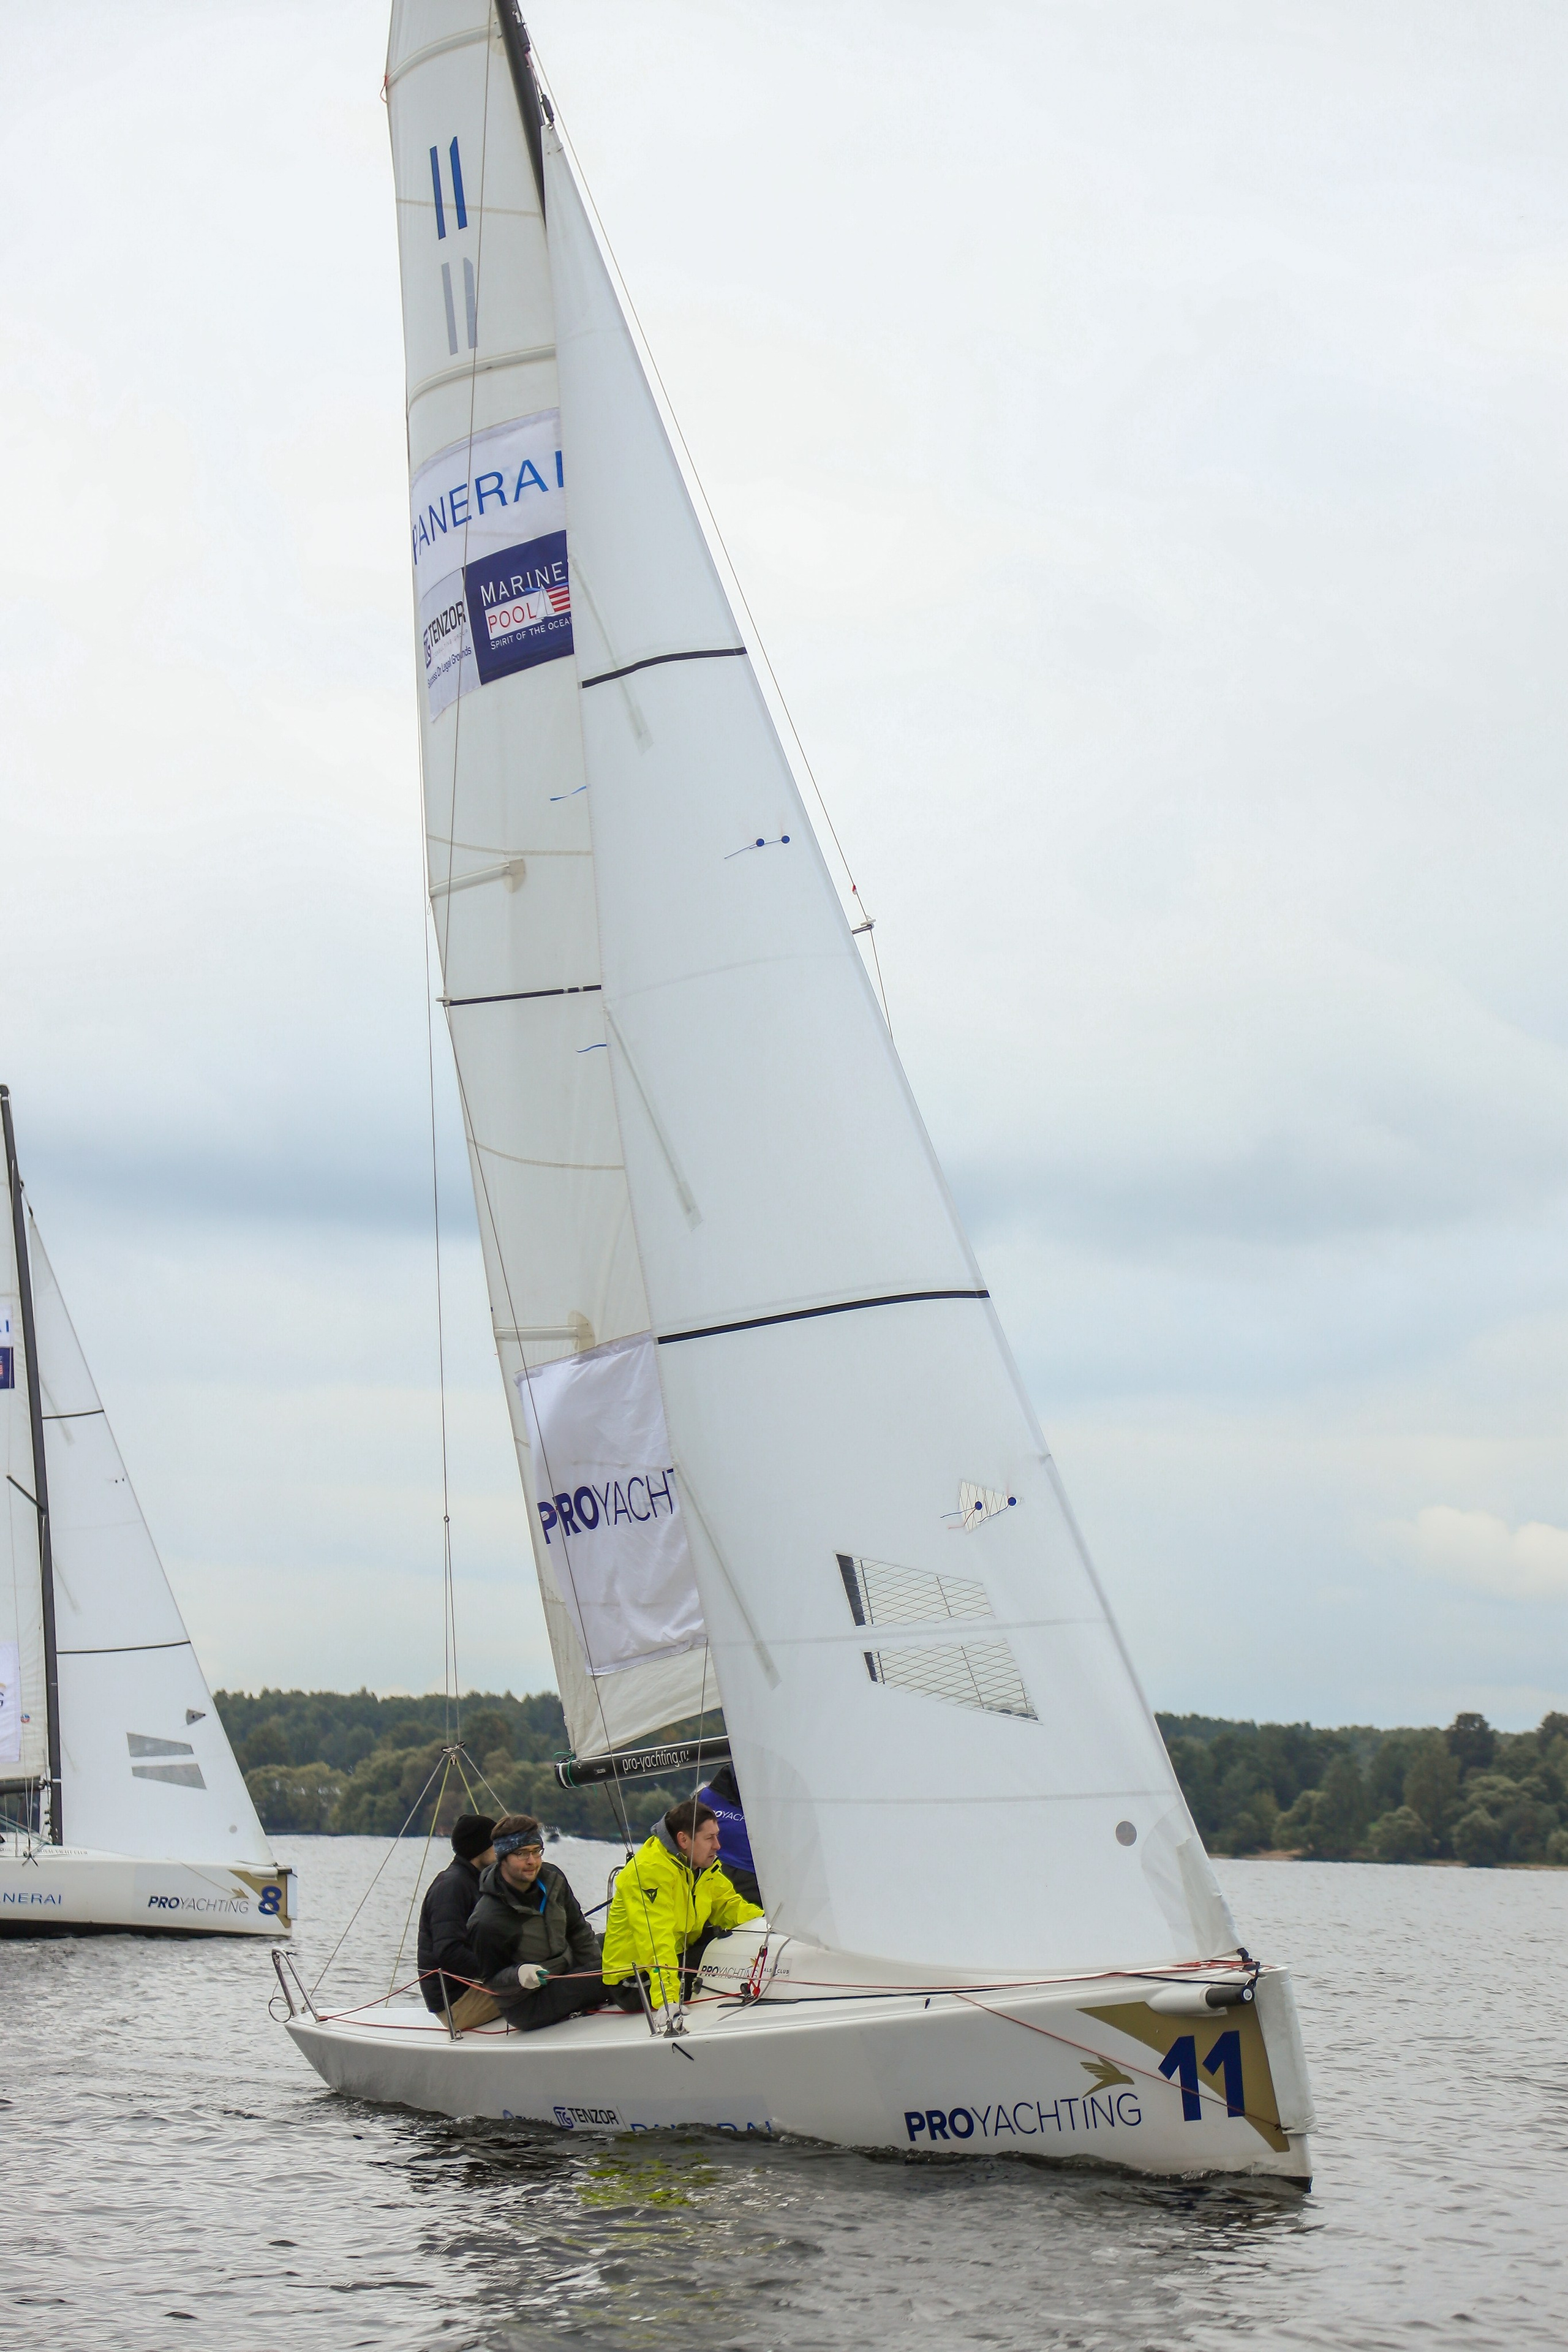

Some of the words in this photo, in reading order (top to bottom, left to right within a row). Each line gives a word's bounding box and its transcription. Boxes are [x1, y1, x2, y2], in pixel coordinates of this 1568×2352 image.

[430, 135, 467, 239] 11
[412, 450, 564, 565] PANERAI
[480, 561, 567, 606] MARINE
[428, 601, 466, 647] TENZOR
[488, 603, 537, 633] POOL
[491, 635, 513, 650] SPIRIT
[516, 631, 526, 641] OF
[529, 625, 546, 636] THE
[537, 1468, 674, 1545] PROYACH
[0, 1892, 61, 1904] NERAI
[148, 1896, 248, 1913] PROYACHTING
[258, 1886, 282, 1915] 8
[1158, 2030, 1246, 2122] 11
[567, 2108, 619, 2125] TENZOR
[904, 2092, 1142, 2142] PROYACHTING
